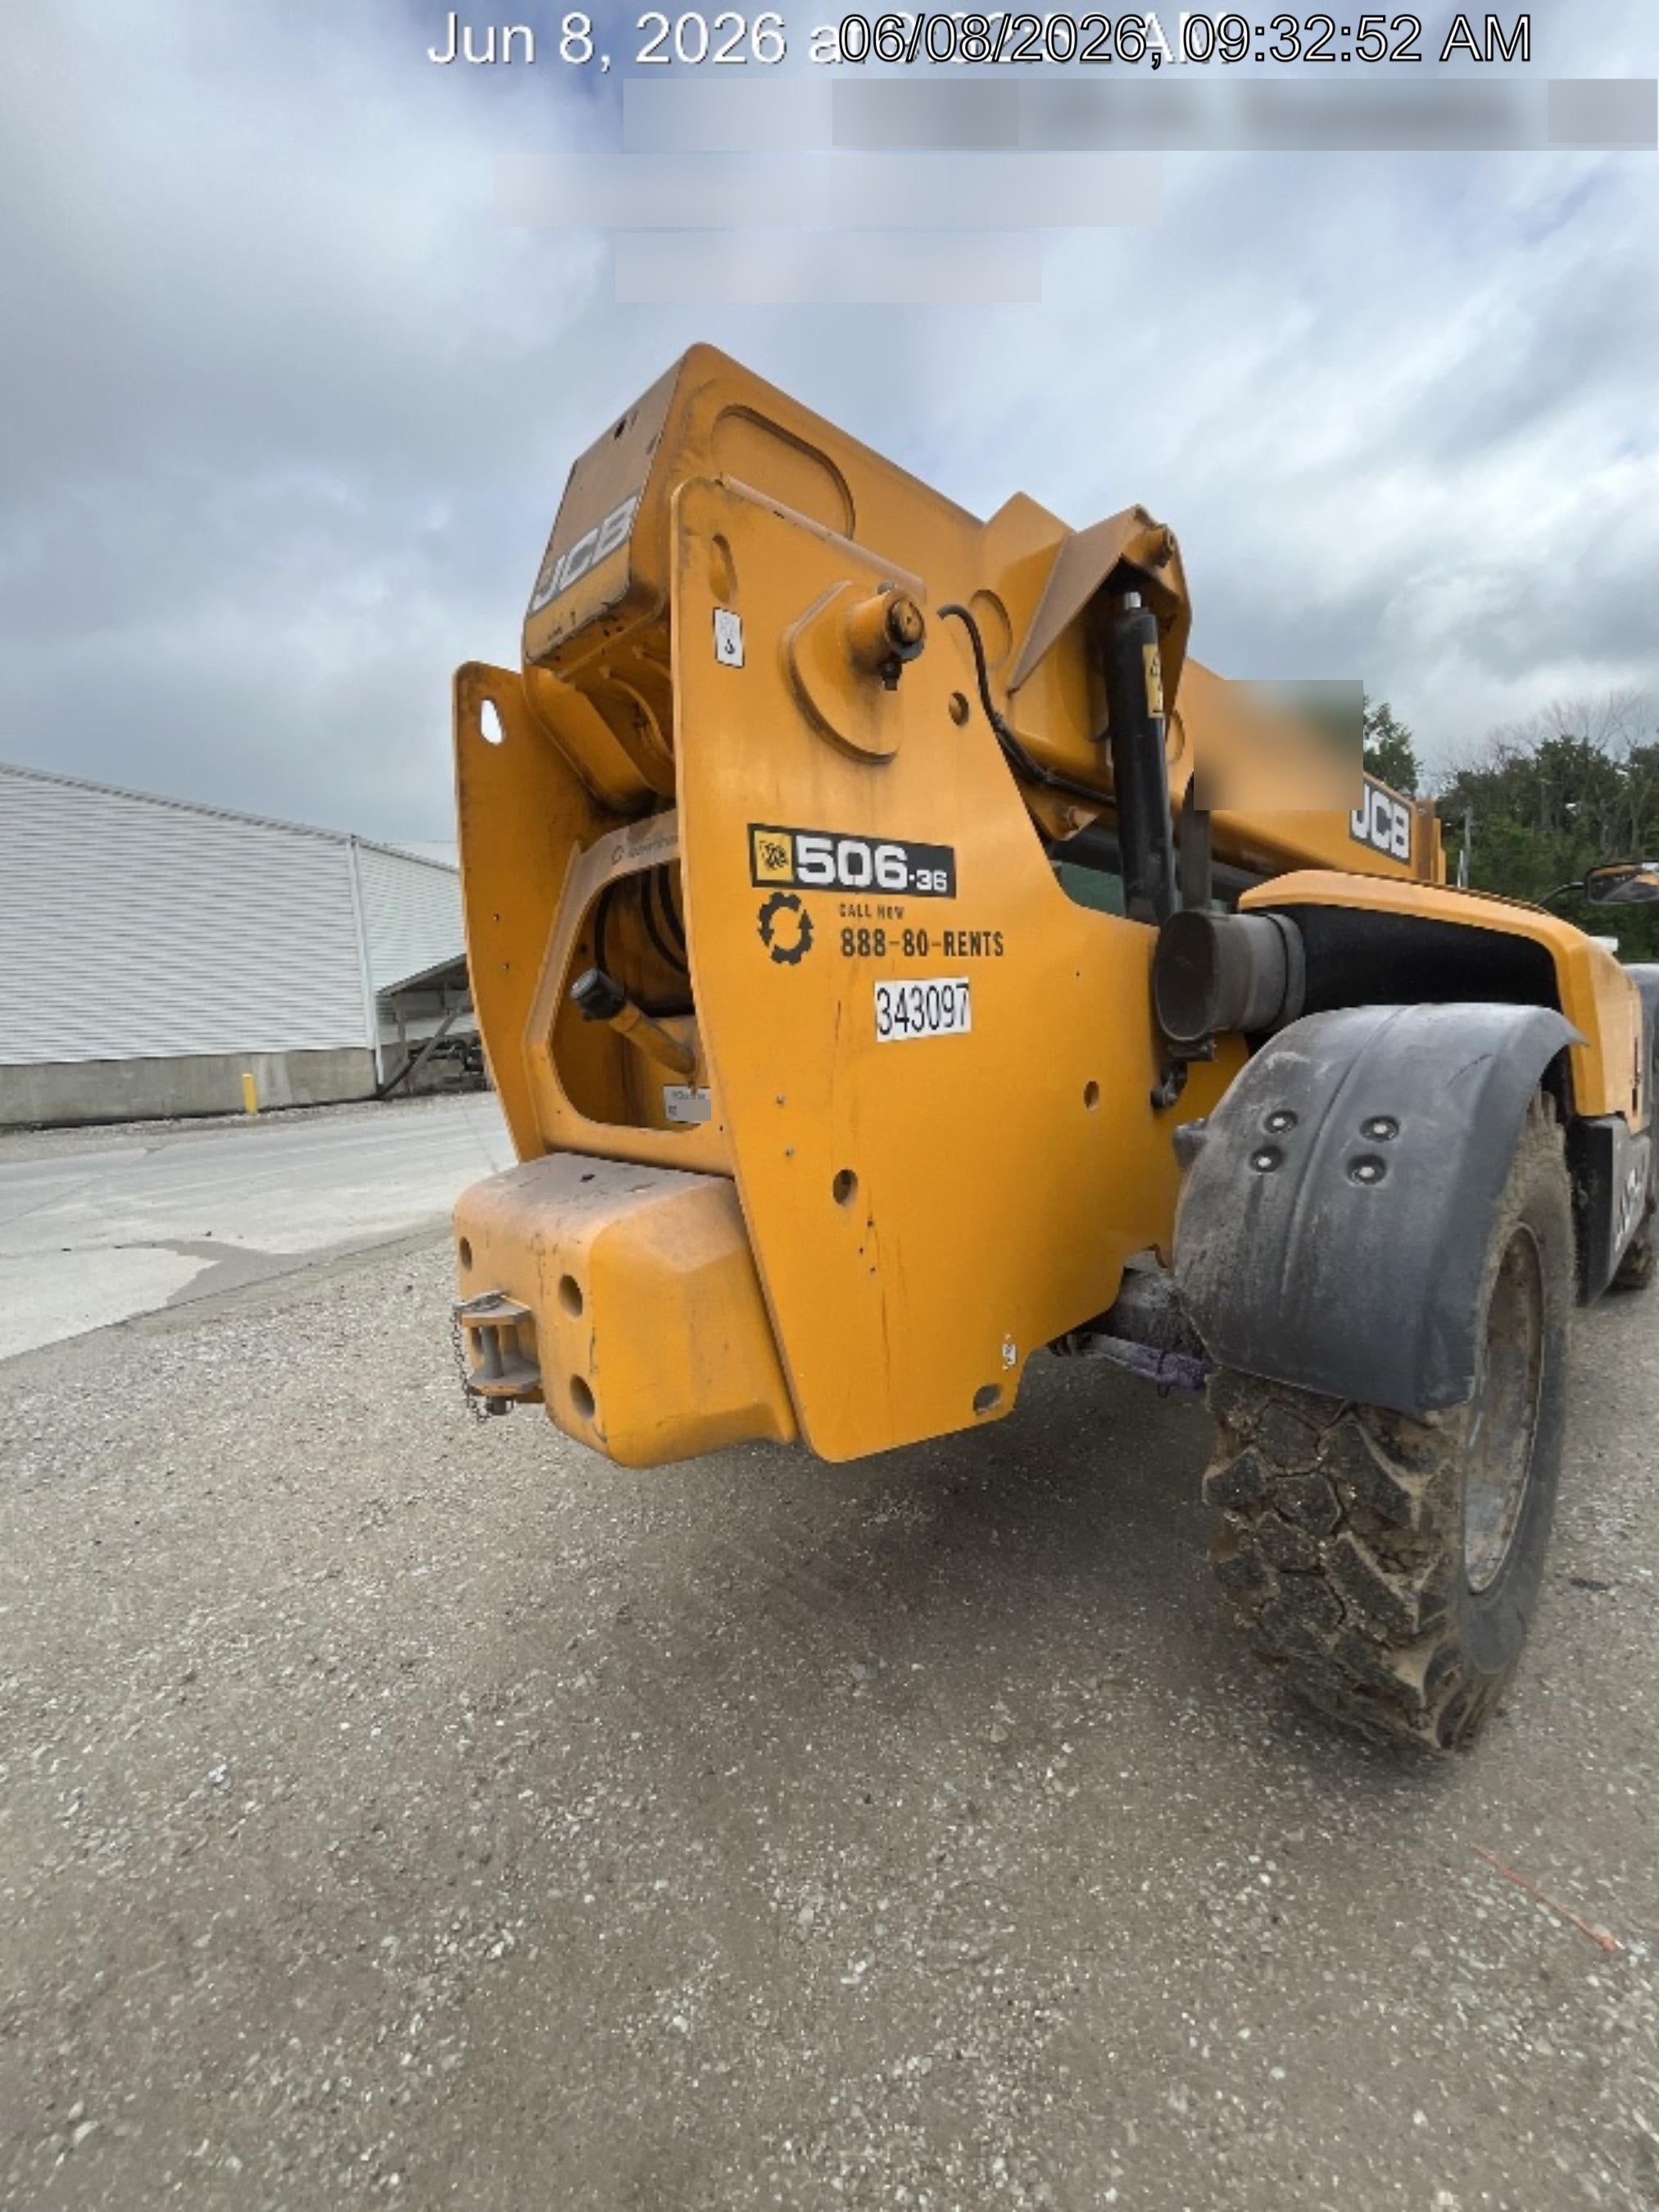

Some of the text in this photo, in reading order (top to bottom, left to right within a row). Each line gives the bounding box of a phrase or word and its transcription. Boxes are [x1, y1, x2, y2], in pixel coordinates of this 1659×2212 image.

[532, 495, 638, 612] JCB
[1351, 782, 1410, 859] JCB
[839, 903, 873, 918] CALL
[841, 927, 1004, 958] 888-80-RENTS
[877, 983, 970, 1036] 343097
